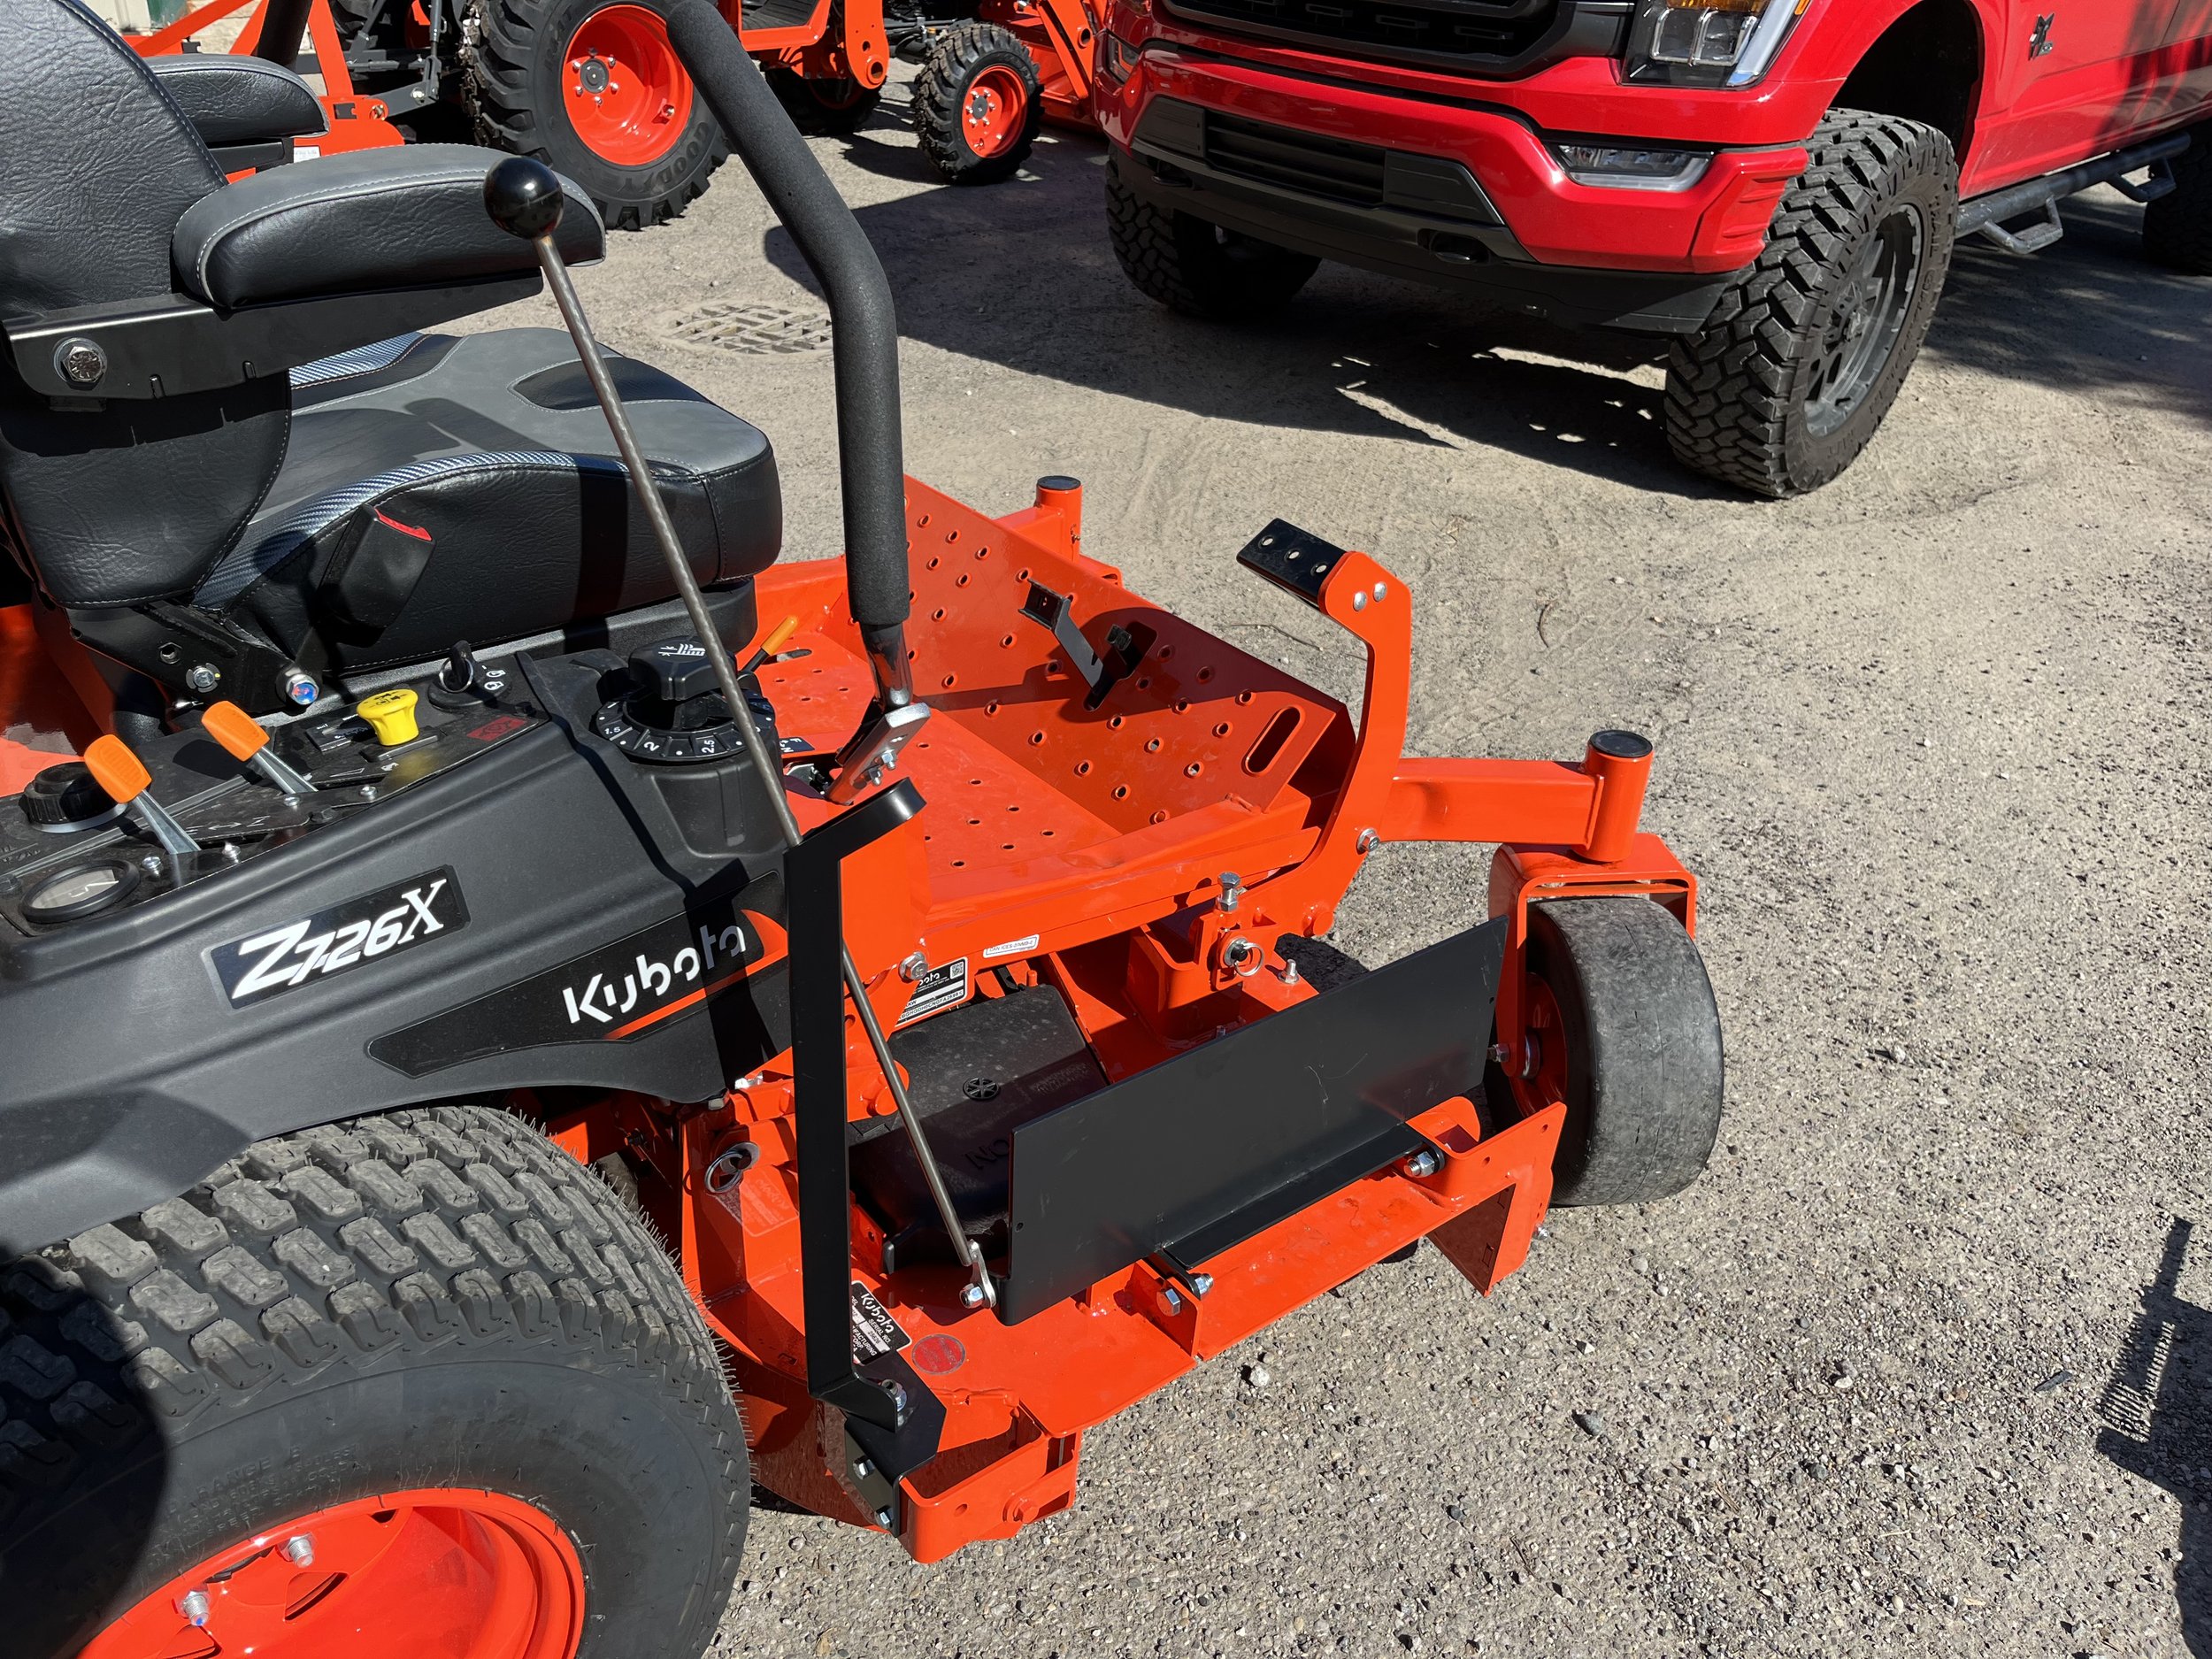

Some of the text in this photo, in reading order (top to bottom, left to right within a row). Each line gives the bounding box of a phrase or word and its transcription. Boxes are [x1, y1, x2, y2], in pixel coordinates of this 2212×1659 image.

[604, 726, 621, 735] 1.5
[643, 741, 660, 751] 2
[702, 740, 715, 753] 2.5
[562, 925, 747, 1024] Kubota
[861, 1293, 895, 1333] Kubota
[868, 1318, 884, 1335] SERIAL
